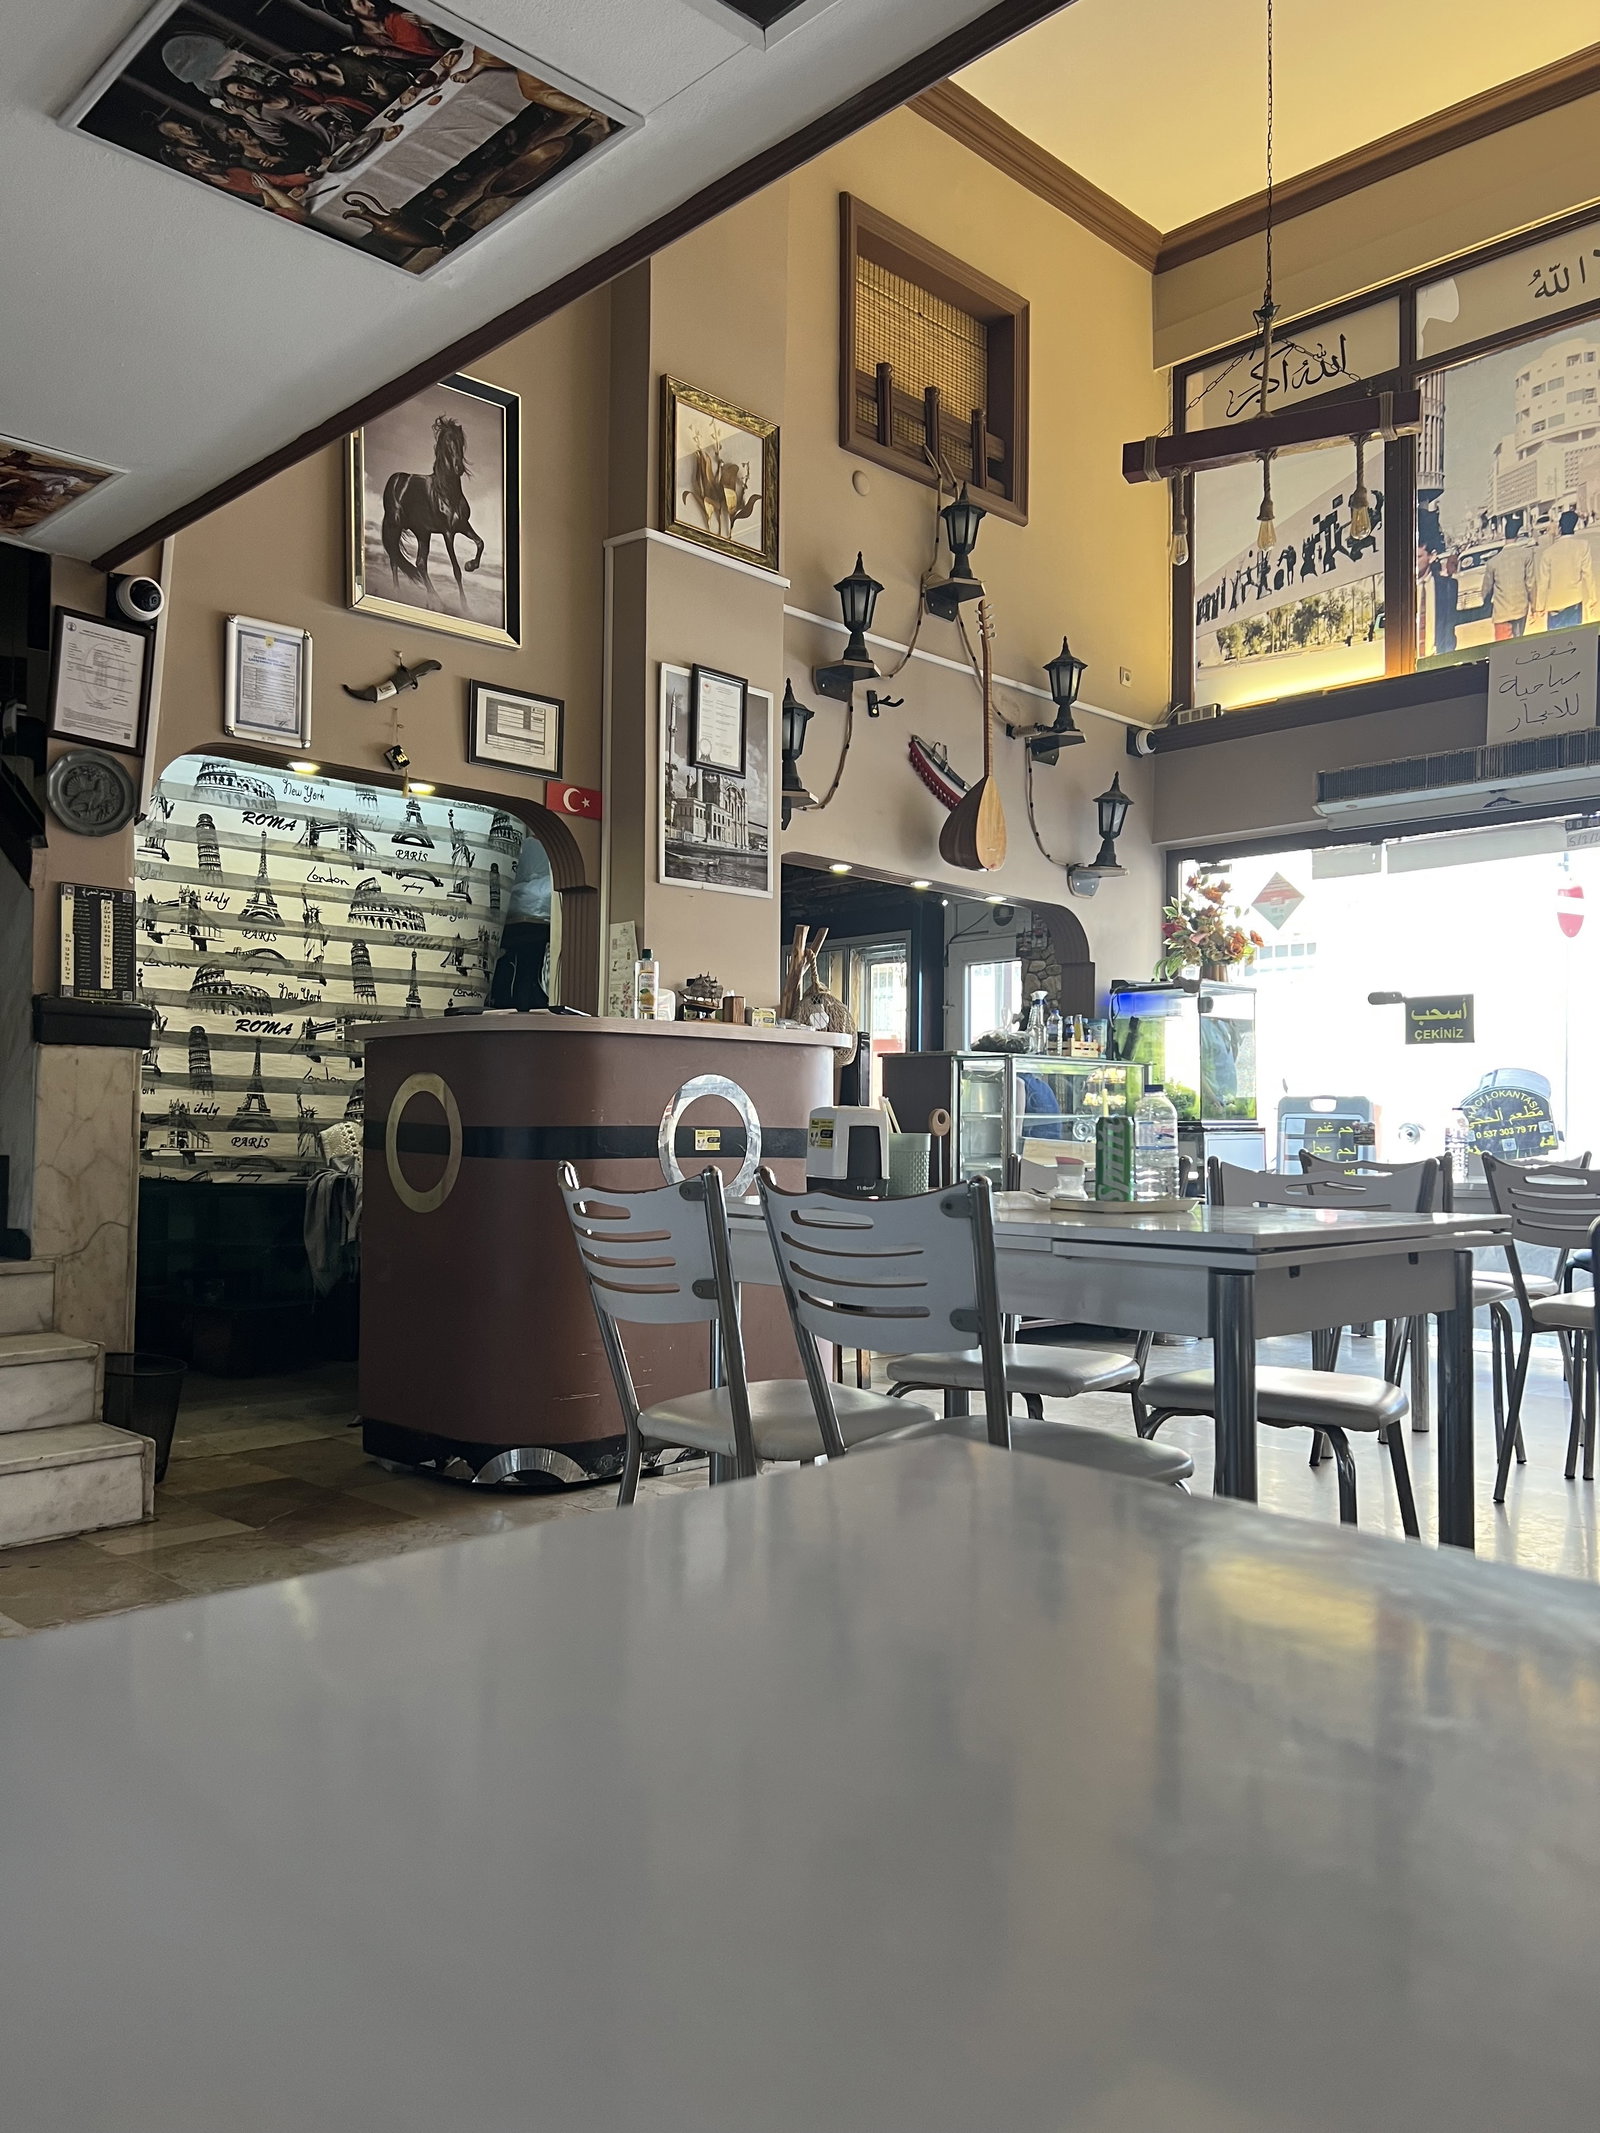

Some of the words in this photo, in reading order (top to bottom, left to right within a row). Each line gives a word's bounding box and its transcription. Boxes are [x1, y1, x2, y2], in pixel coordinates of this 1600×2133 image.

[282, 778, 302, 797] New
[303, 785, 325, 803] York
[241, 810, 298, 832] ROMA
[306, 866, 350, 887] London
[204, 891, 230, 910] italy
[278, 982, 299, 1000] New
[300, 986, 322, 1004] York
[234, 1018, 294, 1036] ROMA
[1414, 1027, 1464, 1042] ÇEKİNİZ
[193, 1102, 221, 1121] italy
